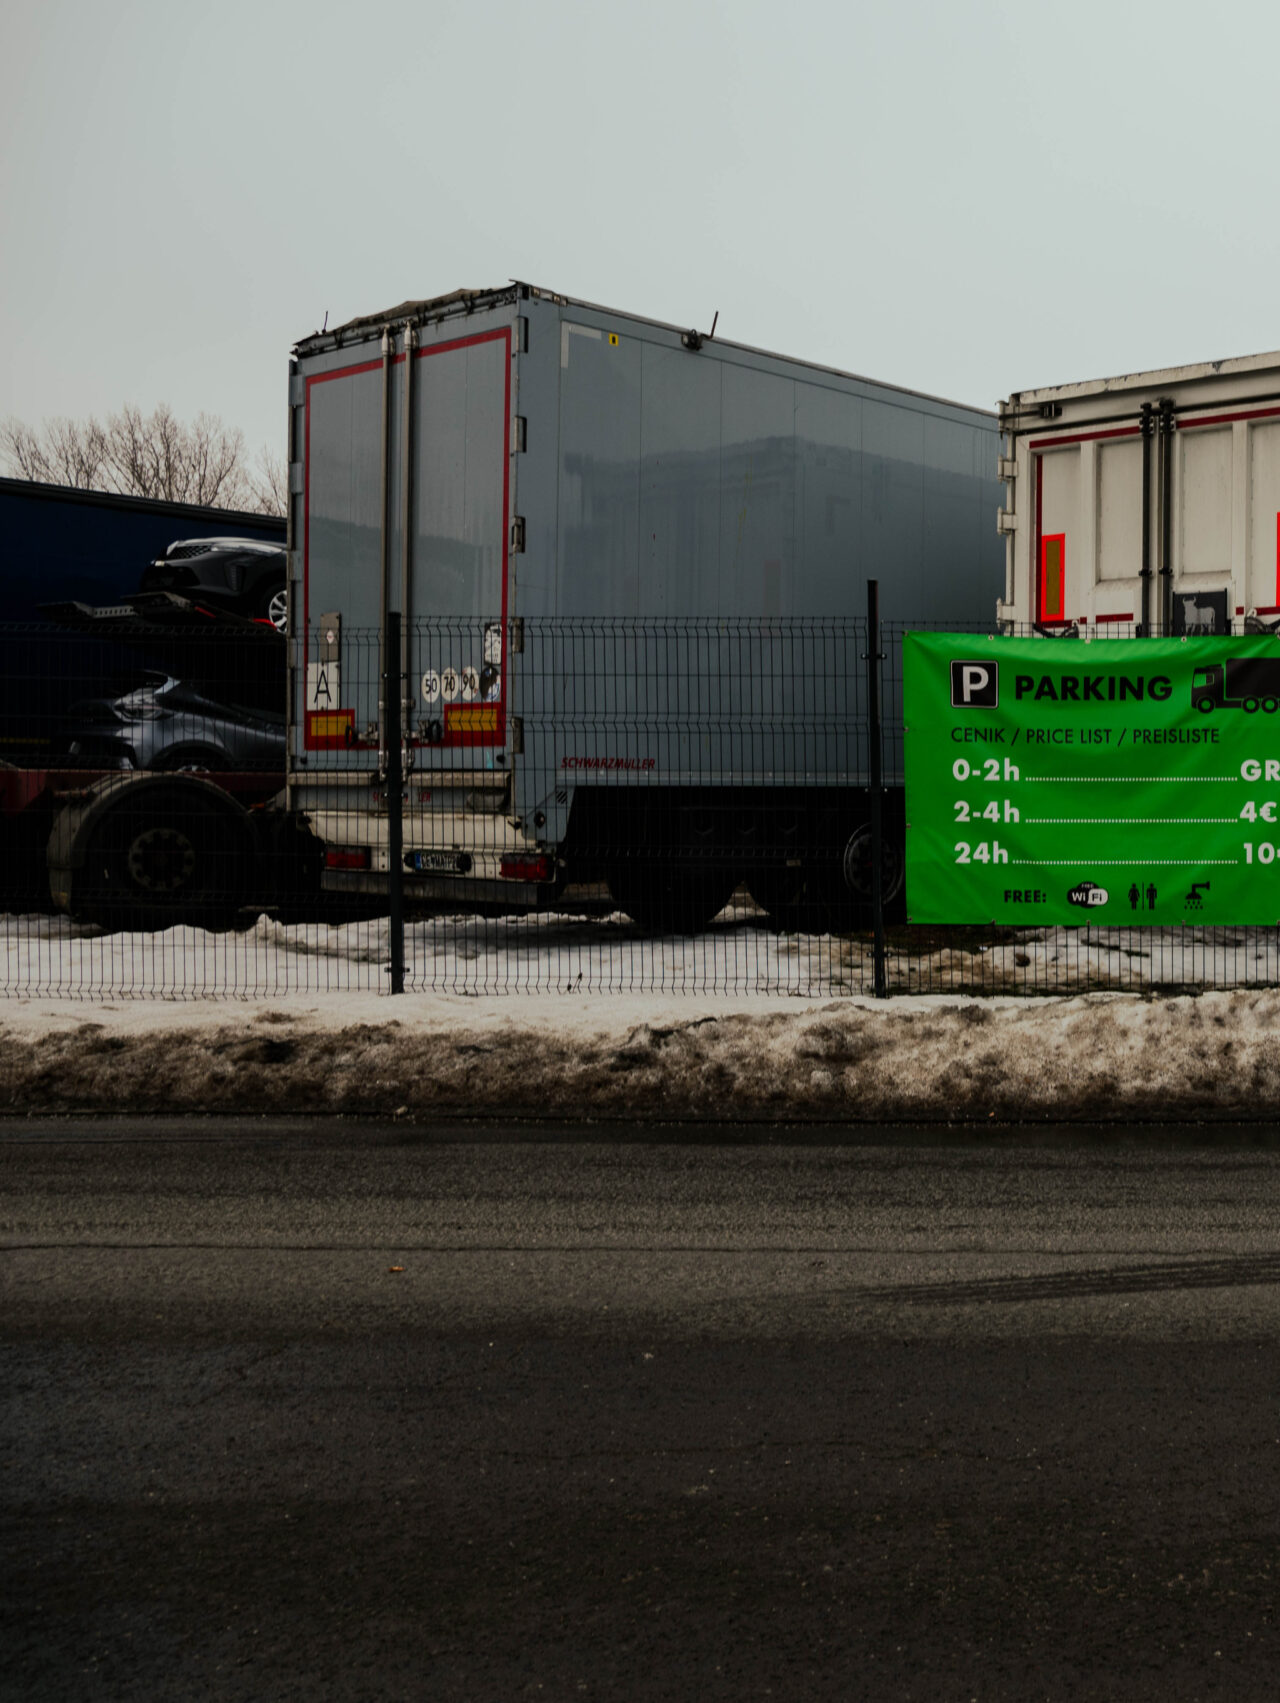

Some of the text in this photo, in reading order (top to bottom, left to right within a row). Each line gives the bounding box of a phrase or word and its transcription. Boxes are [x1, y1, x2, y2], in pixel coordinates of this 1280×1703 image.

[314, 669, 332, 703] A
[425, 678, 438, 694] 50
[444, 675, 456, 693] 70
[462, 674, 476, 691] 90
[962, 666, 1173, 702] P PARKING
[951, 728, 1006, 743] CENIK
[1026, 729, 1074, 744] PRICE
[1080, 729, 1112, 744] LIST
[1133, 728, 1219, 744] PREISLISTE
[952, 757, 1020, 782] 0-2h
[954, 799, 1278, 824] 2-4h 4€
[954, 841, 1009, 864] 24h
[1004, 890, 1047, 903] FREE:
